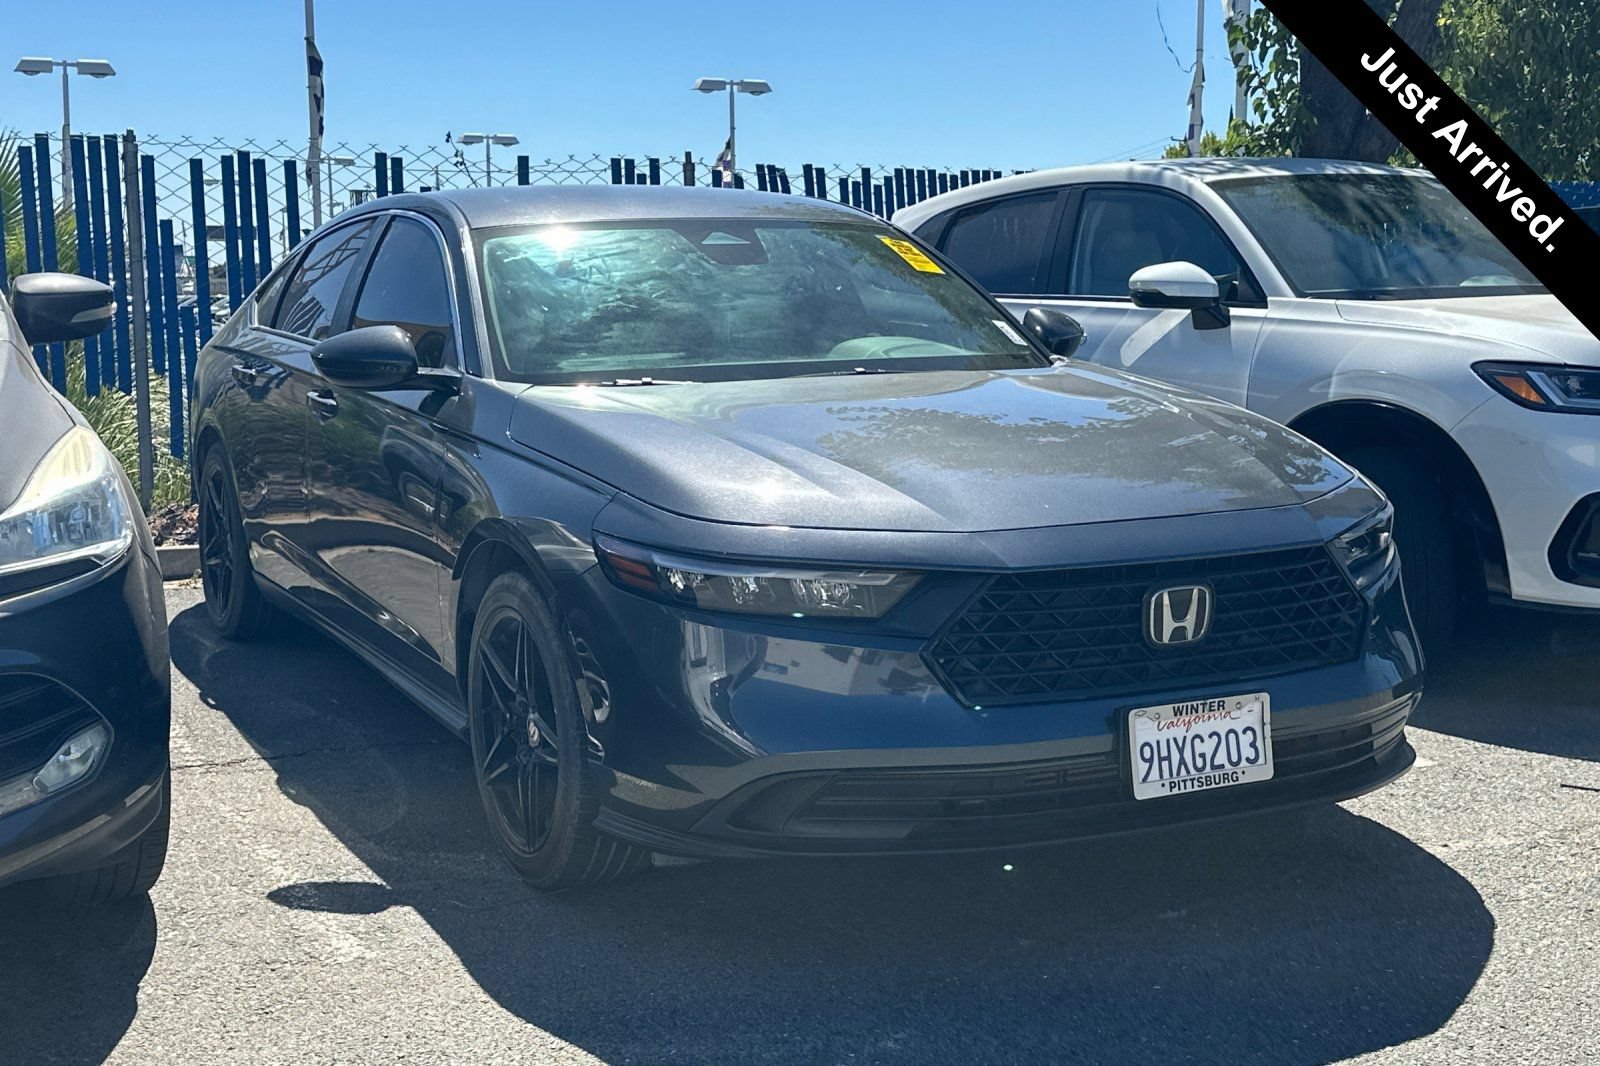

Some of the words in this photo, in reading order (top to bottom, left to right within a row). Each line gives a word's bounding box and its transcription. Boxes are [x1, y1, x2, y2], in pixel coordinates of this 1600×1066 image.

[1172, 700, 1226, 717] WINTER
[1139, 726, 1260, 783] 9HXG203
[1169, 771, 1239, 792] PITTSBURG
